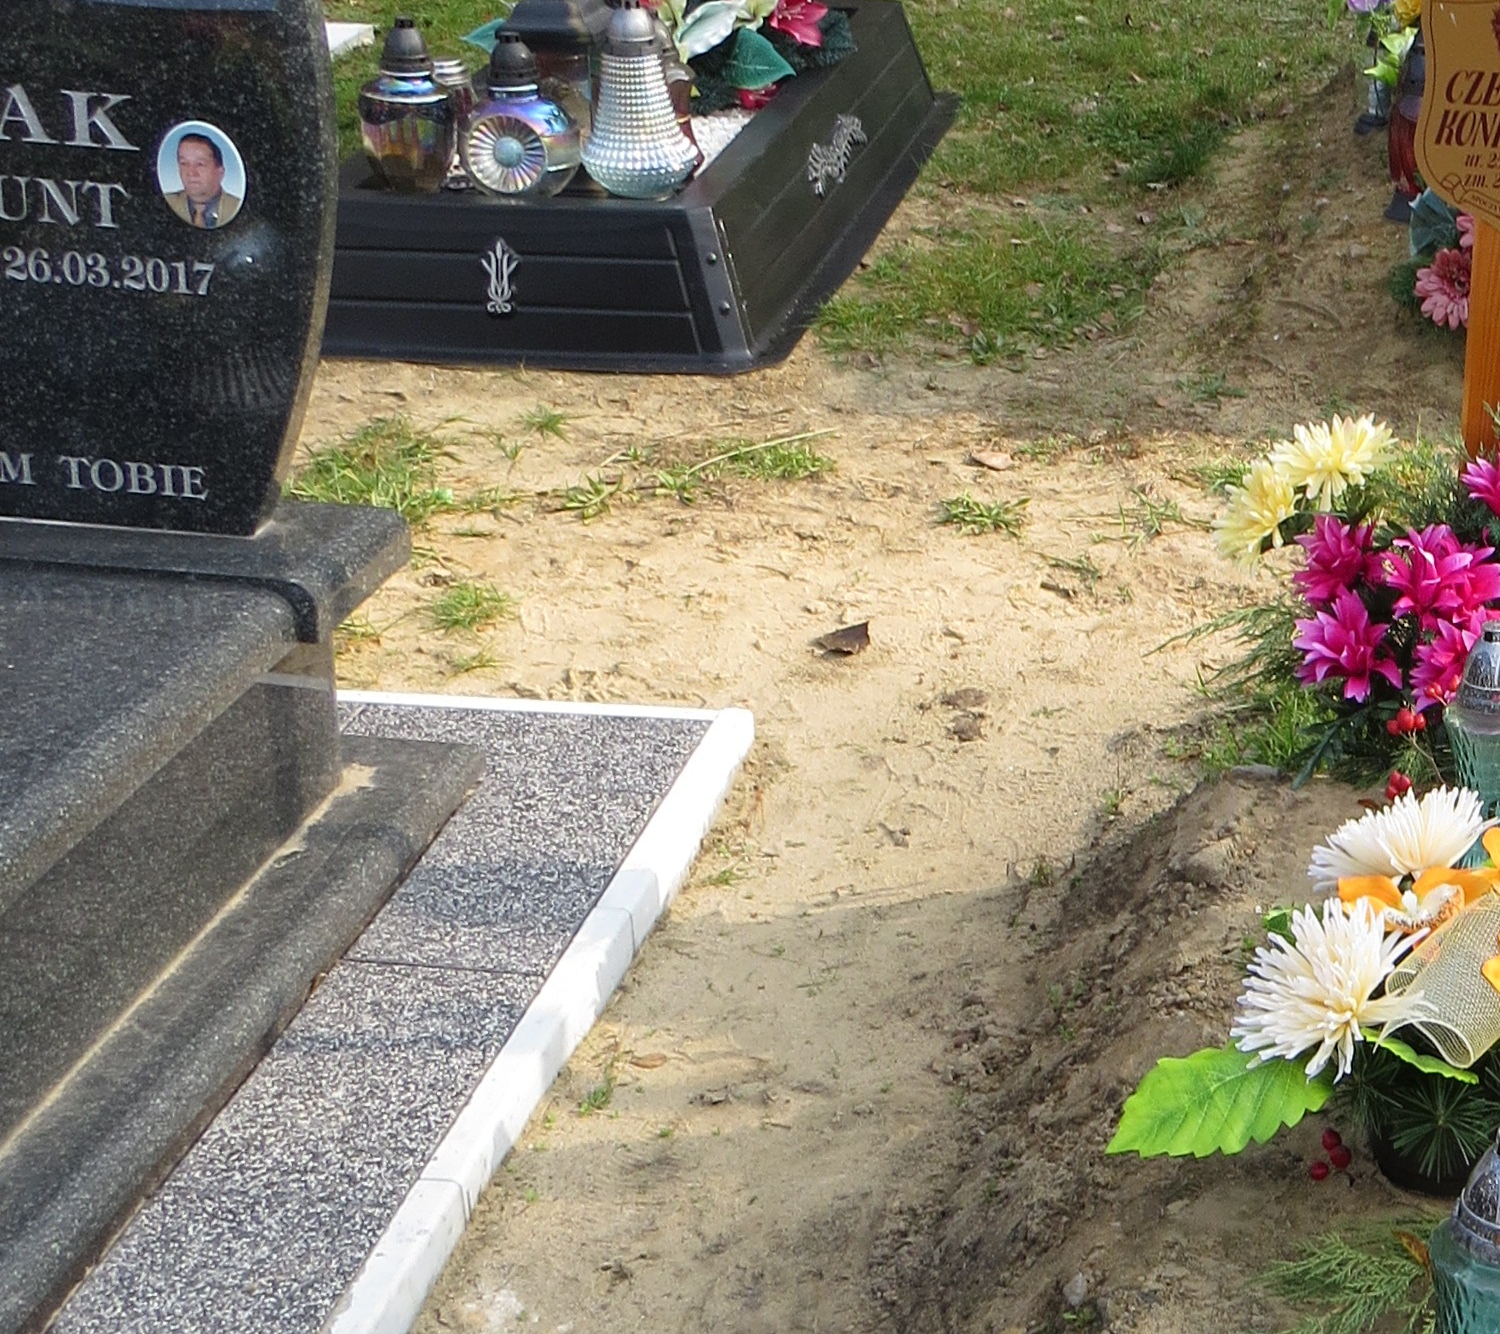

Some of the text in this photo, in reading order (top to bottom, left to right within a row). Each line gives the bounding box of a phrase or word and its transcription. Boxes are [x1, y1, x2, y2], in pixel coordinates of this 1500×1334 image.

[0, 83, 141, 151] AK
[1464, 154, 1483, 167] ur.
[1464, 173, 1488, 188] zm.
[3, 245, 215, 296] 26.03.2017
[58, 454, 210, 501] TOBIE
